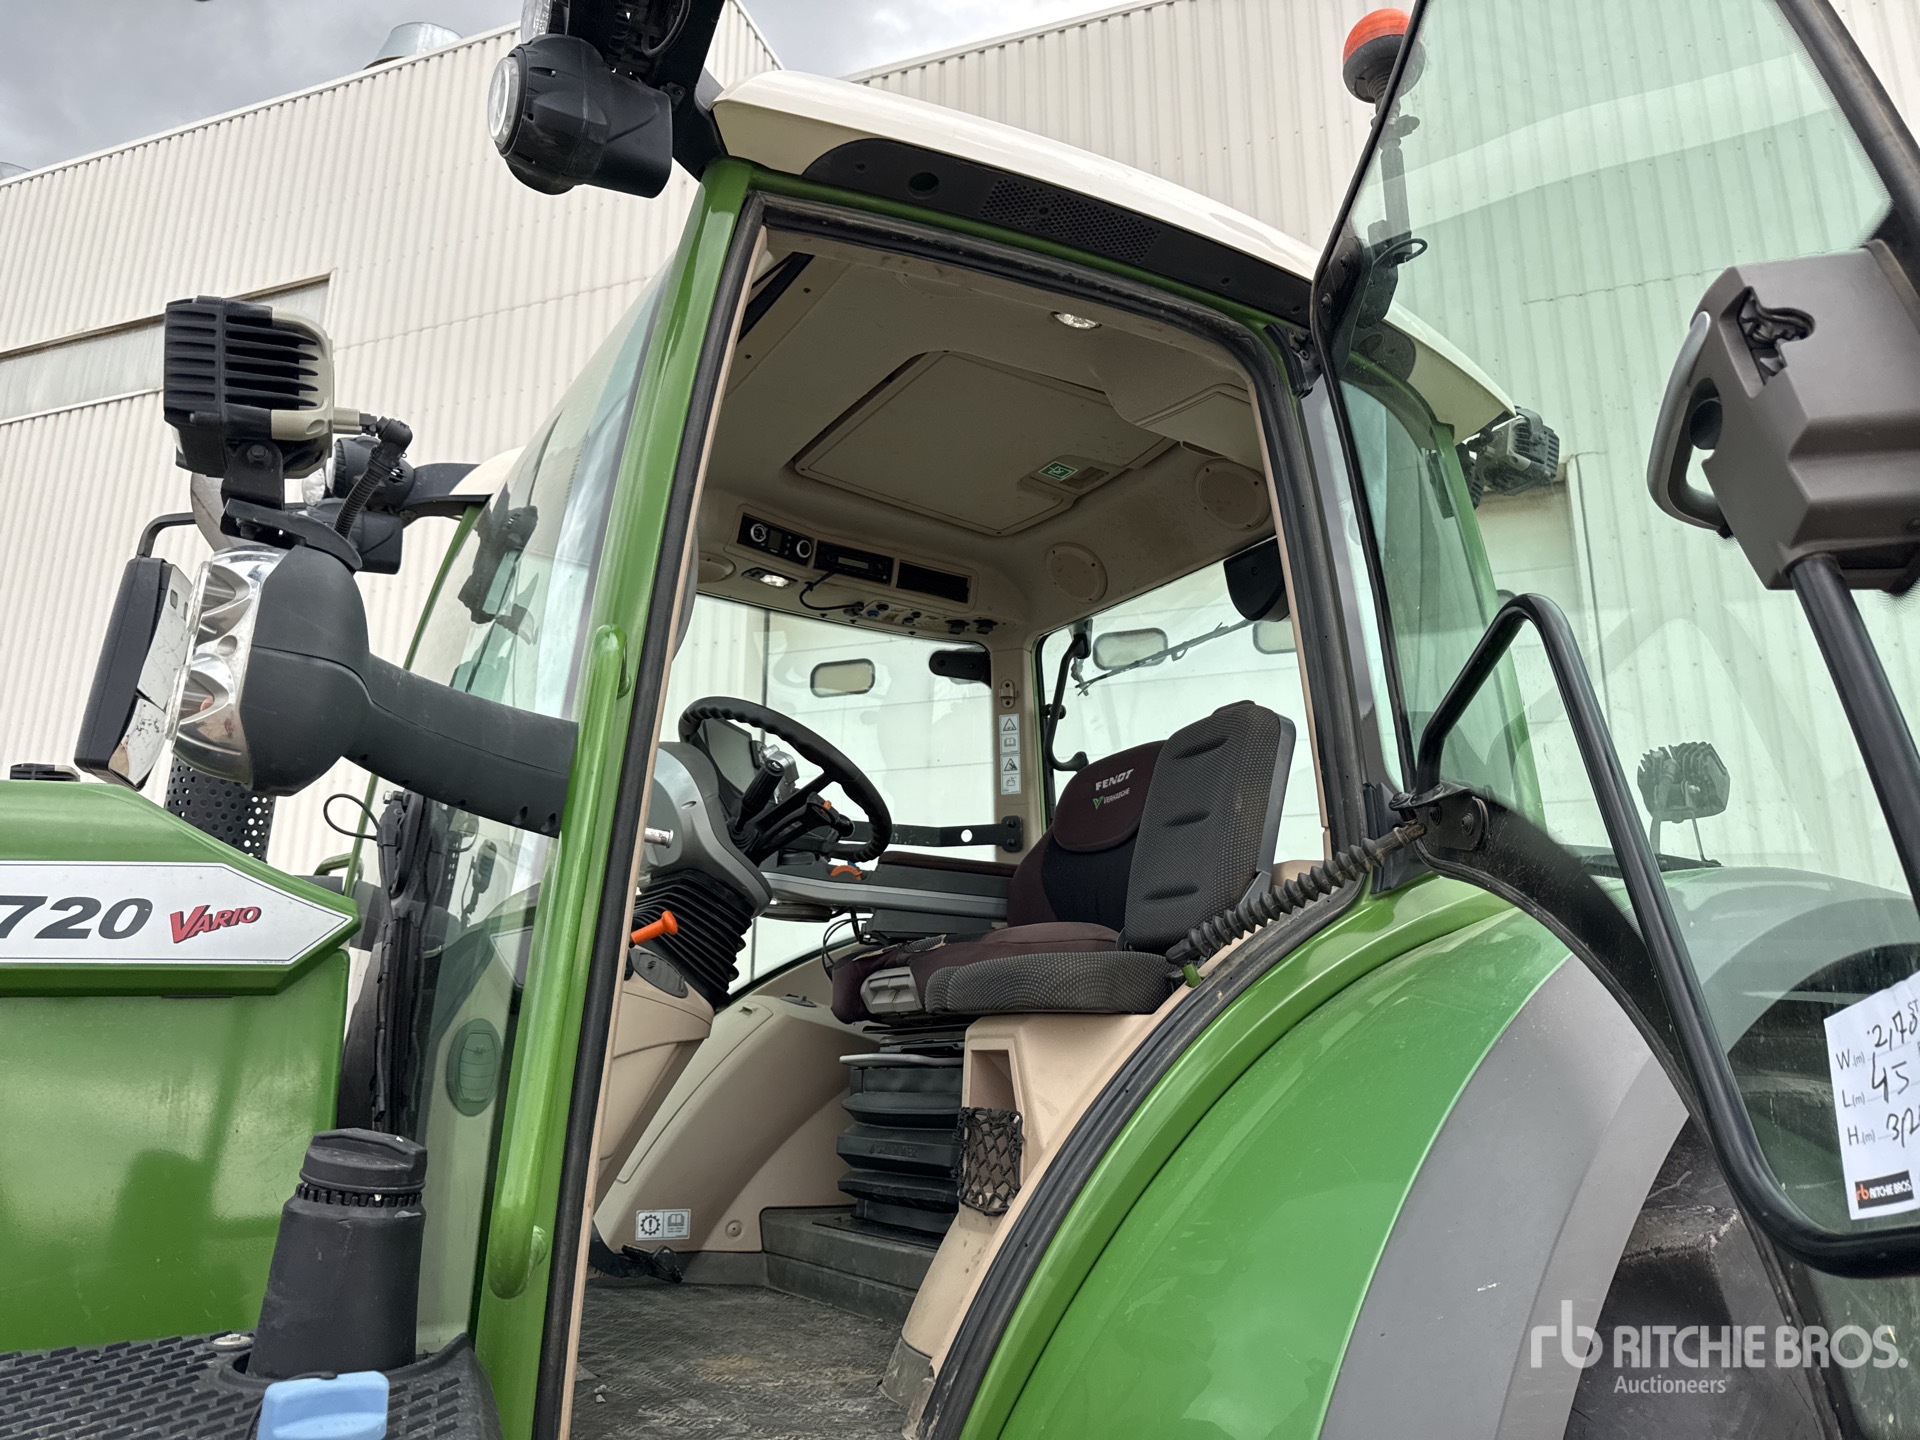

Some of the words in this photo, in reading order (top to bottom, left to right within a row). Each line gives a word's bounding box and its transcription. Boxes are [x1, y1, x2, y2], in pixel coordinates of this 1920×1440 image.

[1095, 768, 1134, 791] FENDT
[0, 896, 153, 939] 720
[169, 904, 262, 944] VARIO
[1869, 1184, 1894, 1200] RITCHIE
